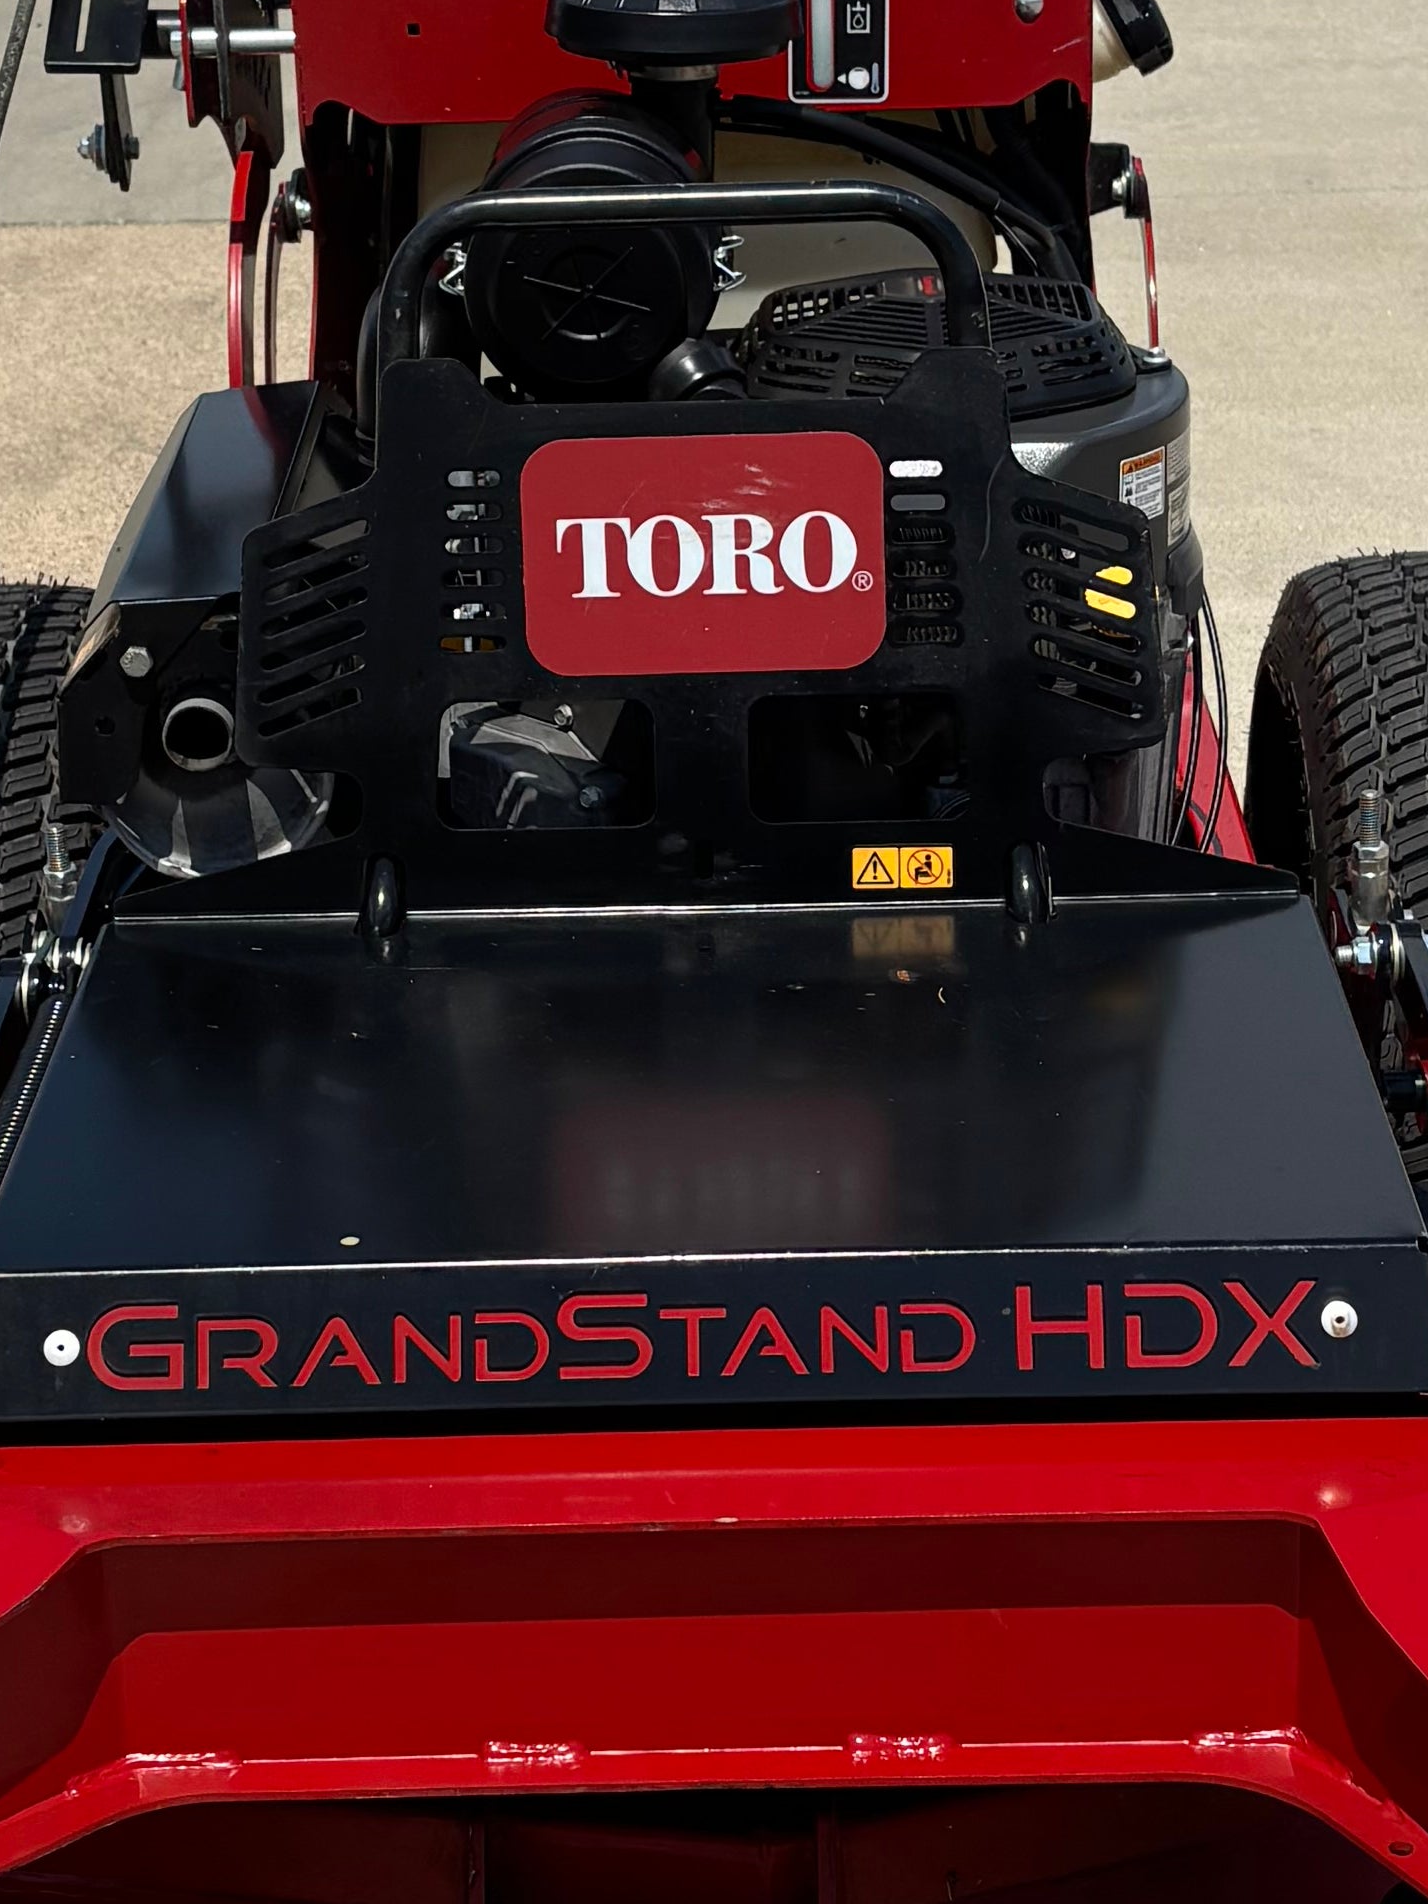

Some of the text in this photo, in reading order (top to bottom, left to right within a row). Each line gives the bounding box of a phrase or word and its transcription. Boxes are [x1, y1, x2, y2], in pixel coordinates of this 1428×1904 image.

[556, 510, 858, 598] TORO
[86, 1278, 1319, 1392] GRANDSTAND HDX
